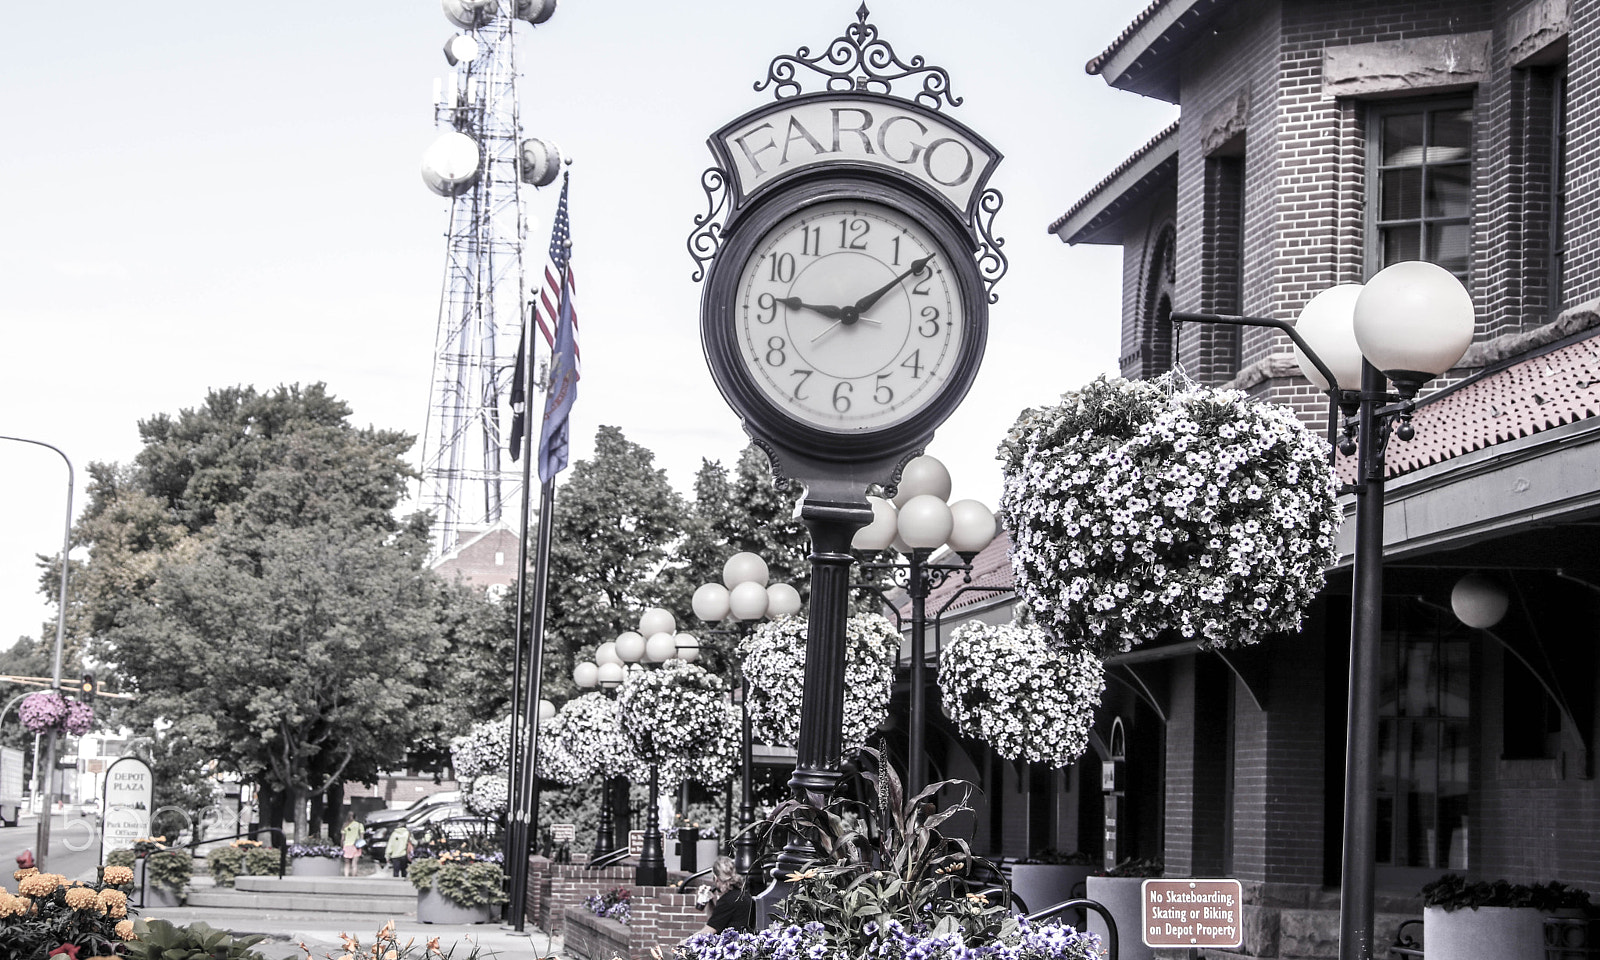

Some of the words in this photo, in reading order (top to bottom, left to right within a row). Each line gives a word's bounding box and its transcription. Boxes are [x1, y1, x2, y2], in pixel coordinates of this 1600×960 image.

[734, 107, 974, 187] FARGO
[800, 225, 822, 257] 11
[838, 218, 871, 250] 12
[891, 235, 901, 266] 1
[768, 251, 796, 283] 10
[912, 263, 934, 296] 2
[757, 292, 778, 324] 9
[918, 305, 940, 338] 3
[765, 335, 786, 367] 8
[901, 348, 925, 379] 4
[790, 369, 813, 401] 7
[832, 381, 853, 413] 6
[873, 372, 894, 405] 5
[113, 783, 145, 791] PLAZA
[114, 773, 145, 781] DEPOT
[1150, 890, 1163, 903] No
[1166, 890, 1235, 906] Skateboarding,
[1152, 906, 1187, 922] Skating
[1189, 909, 1201, 919] or
[1203, 906, 1234, 922] Biking
[1149, 925, 1162, 935] on
[1165, 922, 1193, 939] Depot
[1196, 922, 1237, 939] Property
